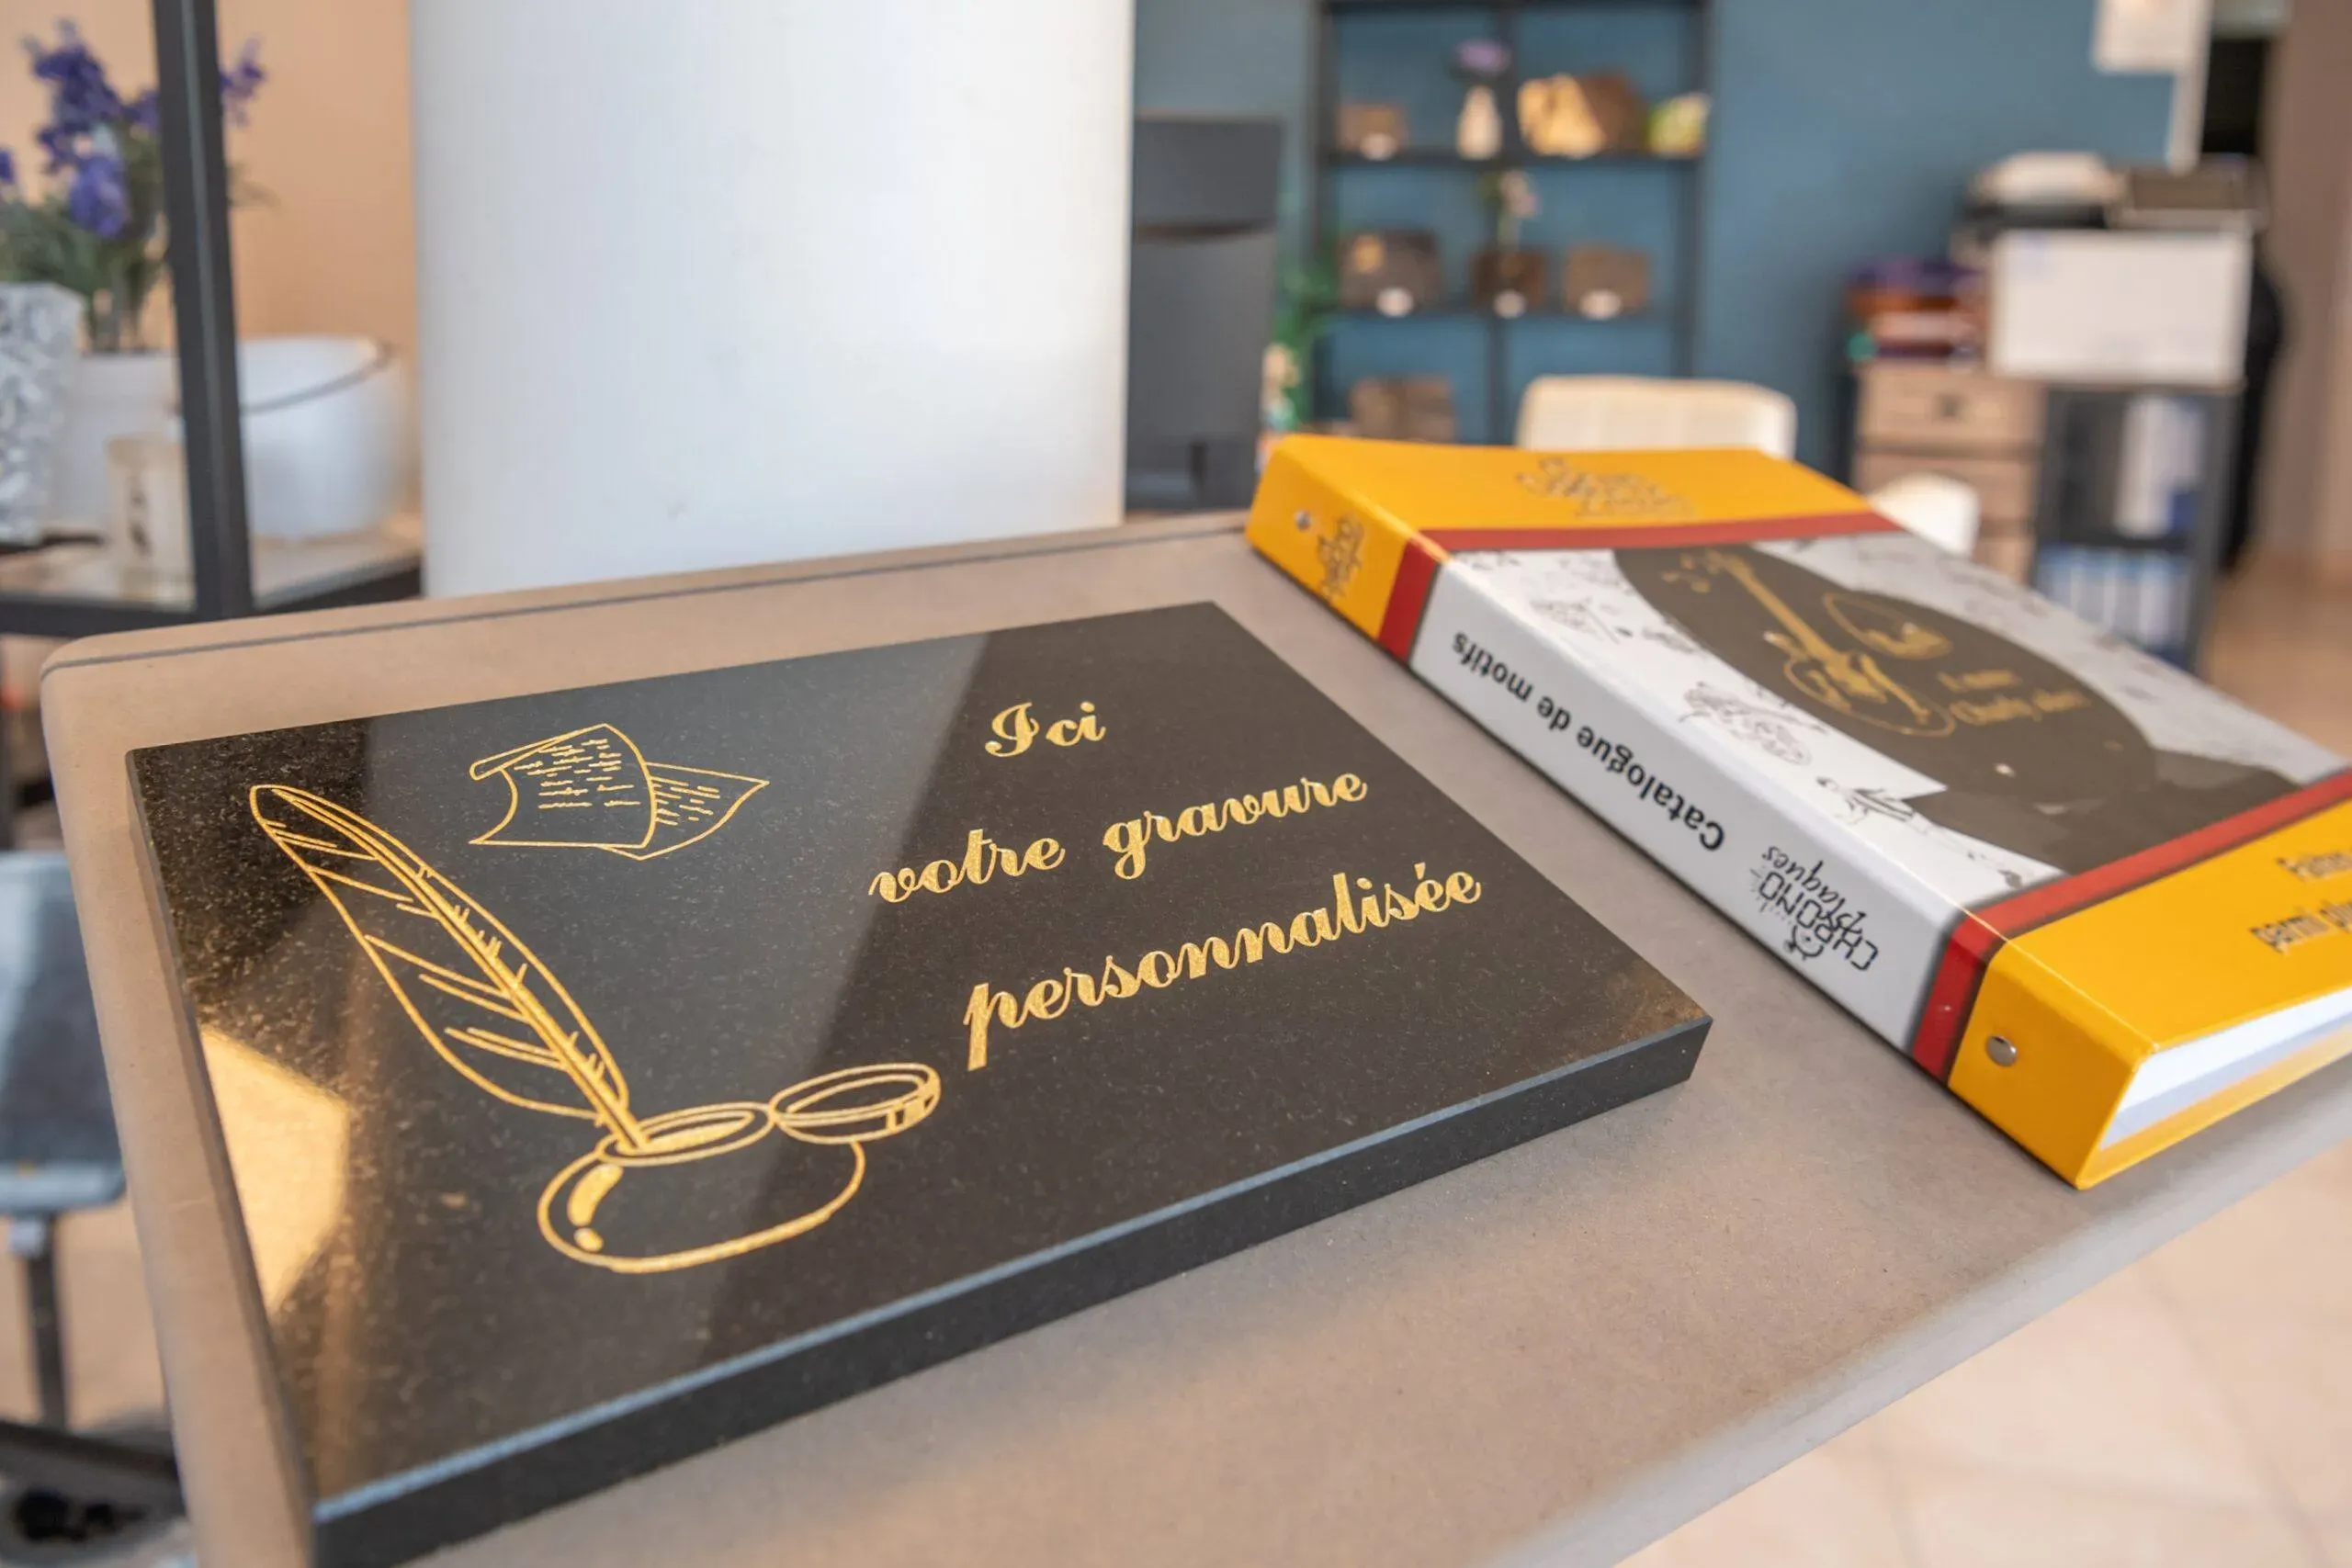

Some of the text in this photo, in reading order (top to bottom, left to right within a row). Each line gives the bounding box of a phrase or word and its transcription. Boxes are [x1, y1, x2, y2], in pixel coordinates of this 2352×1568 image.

[985, 701, 1106, 757] Ici
[1452, 631, 1725, 852] Catalogue de motifs
[868, 773, 1368, 903] votre gravure
[963, 862, 1482, 1070] personnalisée
[1758, 871, 1878, 971] CHRONO
